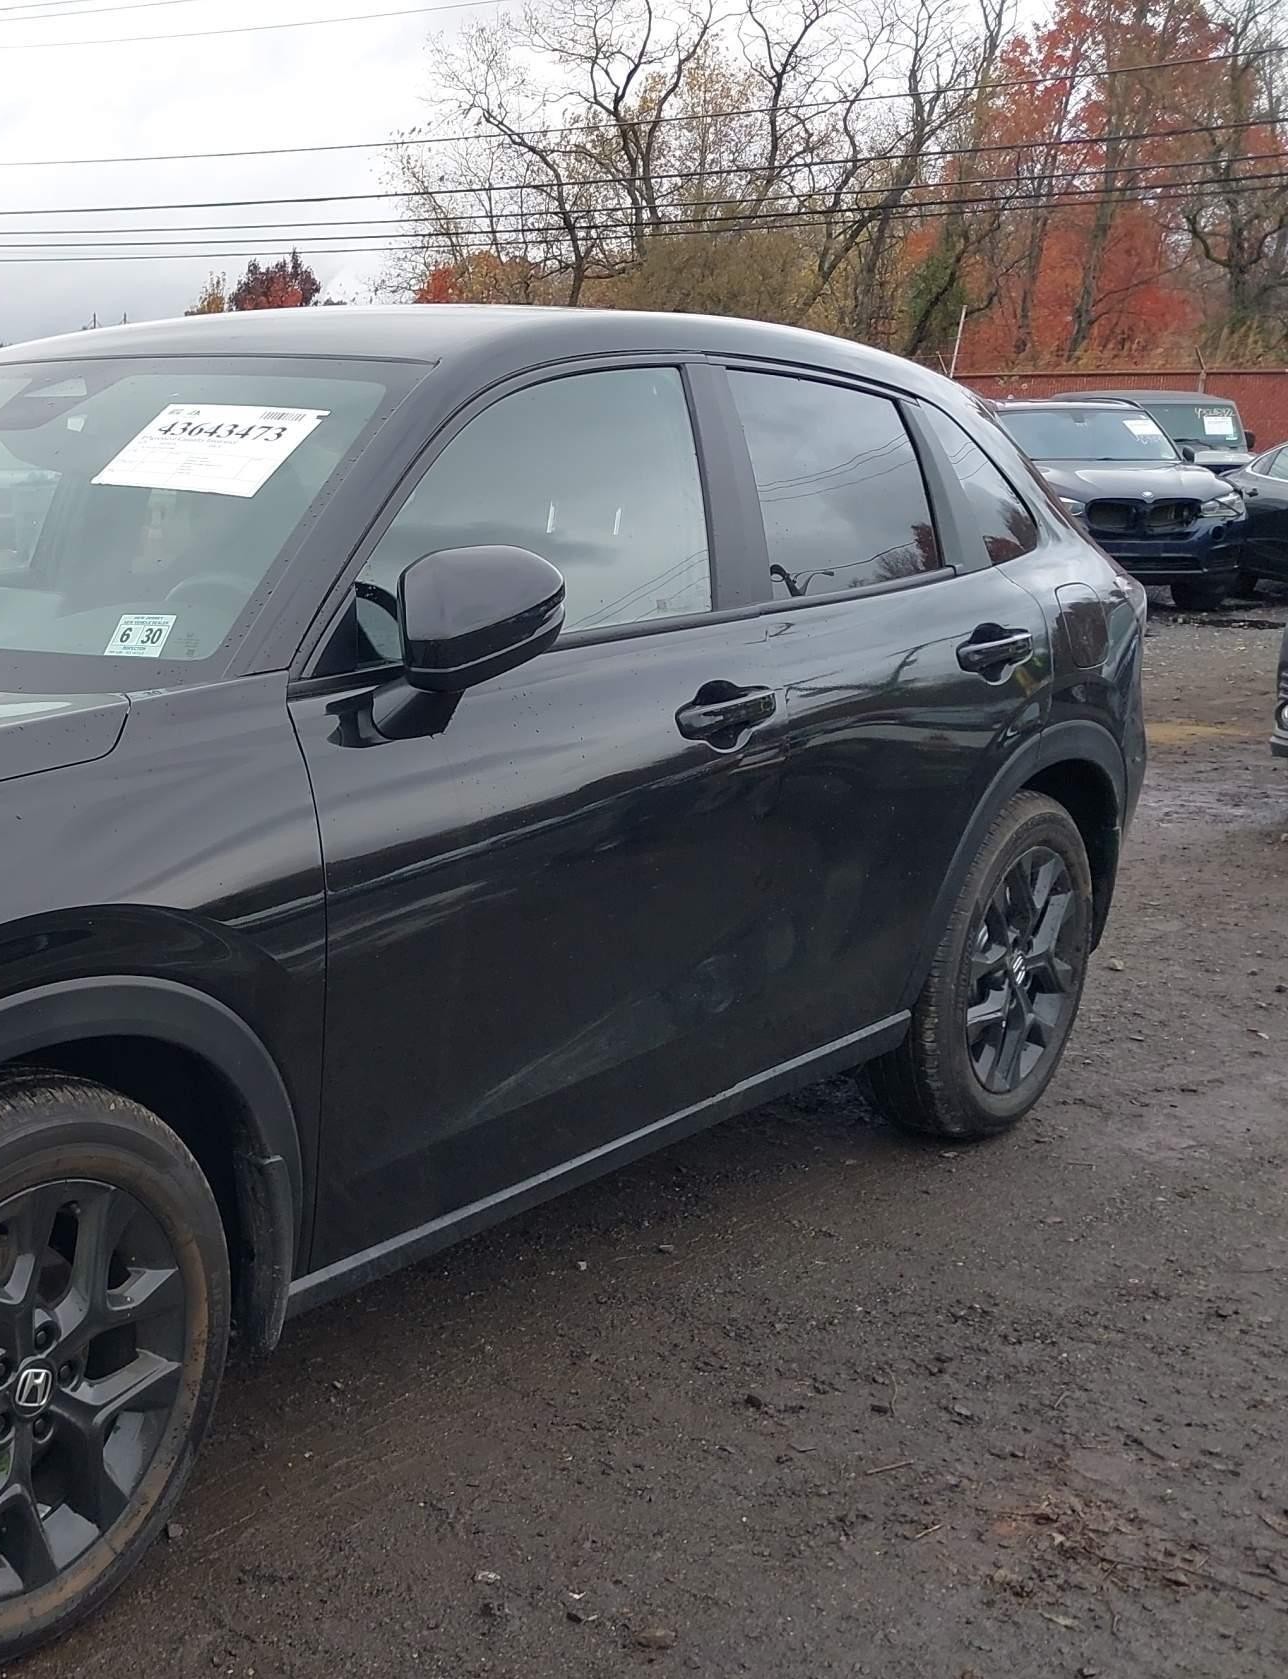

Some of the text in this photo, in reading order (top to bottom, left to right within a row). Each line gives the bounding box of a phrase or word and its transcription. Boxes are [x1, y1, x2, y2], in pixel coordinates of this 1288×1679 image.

[157, 420, 288, 442] 43643473
[119, 627, 133, 643] 6
[140, 627, 163, 644] 30
